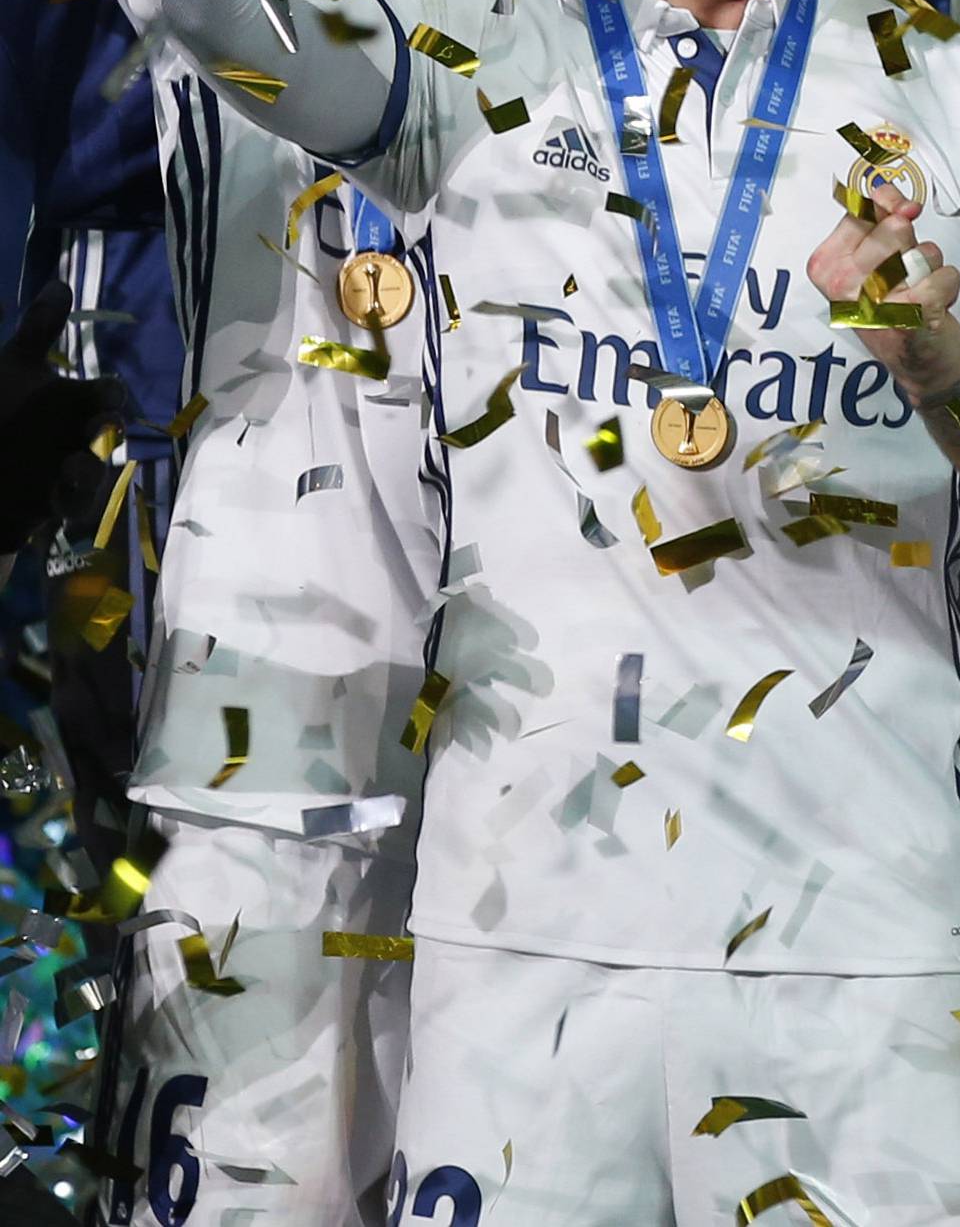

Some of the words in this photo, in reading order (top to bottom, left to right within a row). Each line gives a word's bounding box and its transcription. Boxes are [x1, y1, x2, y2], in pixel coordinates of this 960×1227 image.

[598, 3, 615, 33] FIFA
[611, 49, 629, 81] FIFA
[781, 36, 799, 68] FIFA
[767, 82, 785, 115] FIFA
[532, 143, 611, 182] adidas
[753, 130, 772, 162] FIFA
[636, 153, 650, 180] FIF
[738, 177, 758, 213] FIFA
[723, 230, 742, 266] FIFA
[655, 252, 672, 285] FIFA
[707, 282, 727, 318] FIFA
[668, 305, 684, 339] FIFA
[520, 303, 914, 429] Emrates
